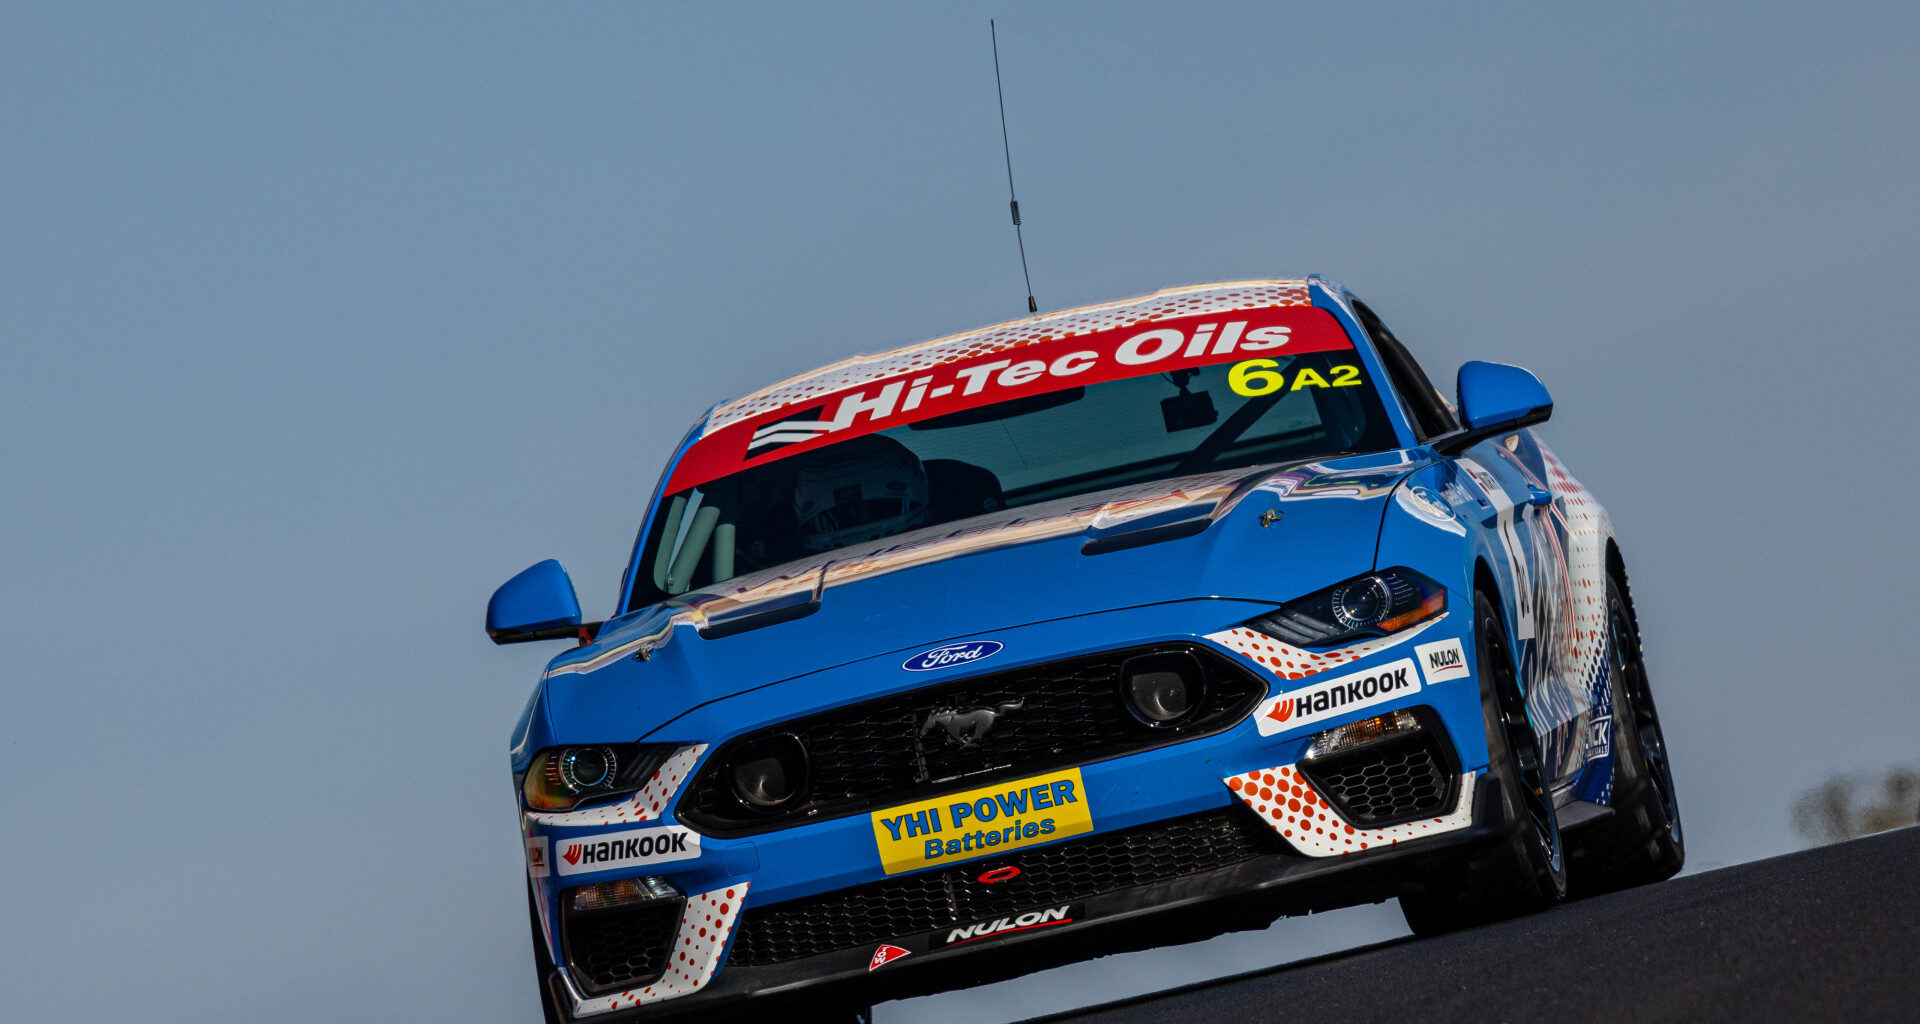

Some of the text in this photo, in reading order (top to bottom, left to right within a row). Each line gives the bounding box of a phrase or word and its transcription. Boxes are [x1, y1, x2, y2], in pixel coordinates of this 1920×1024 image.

[829, 320, 1293, 433] Hi-Tec Oils
[1227, 357, 1363, 397] 6 A2
[922, 645, 982, 668] Ford
[1429, 648, 1460, 668] NULON
[880, 779, 1078, 841] YHI POWER
[924, 818, 1056, 860] Batteries
[946, 905, 1070, 943] NULON
[874, 946, 889, 964] TOW
